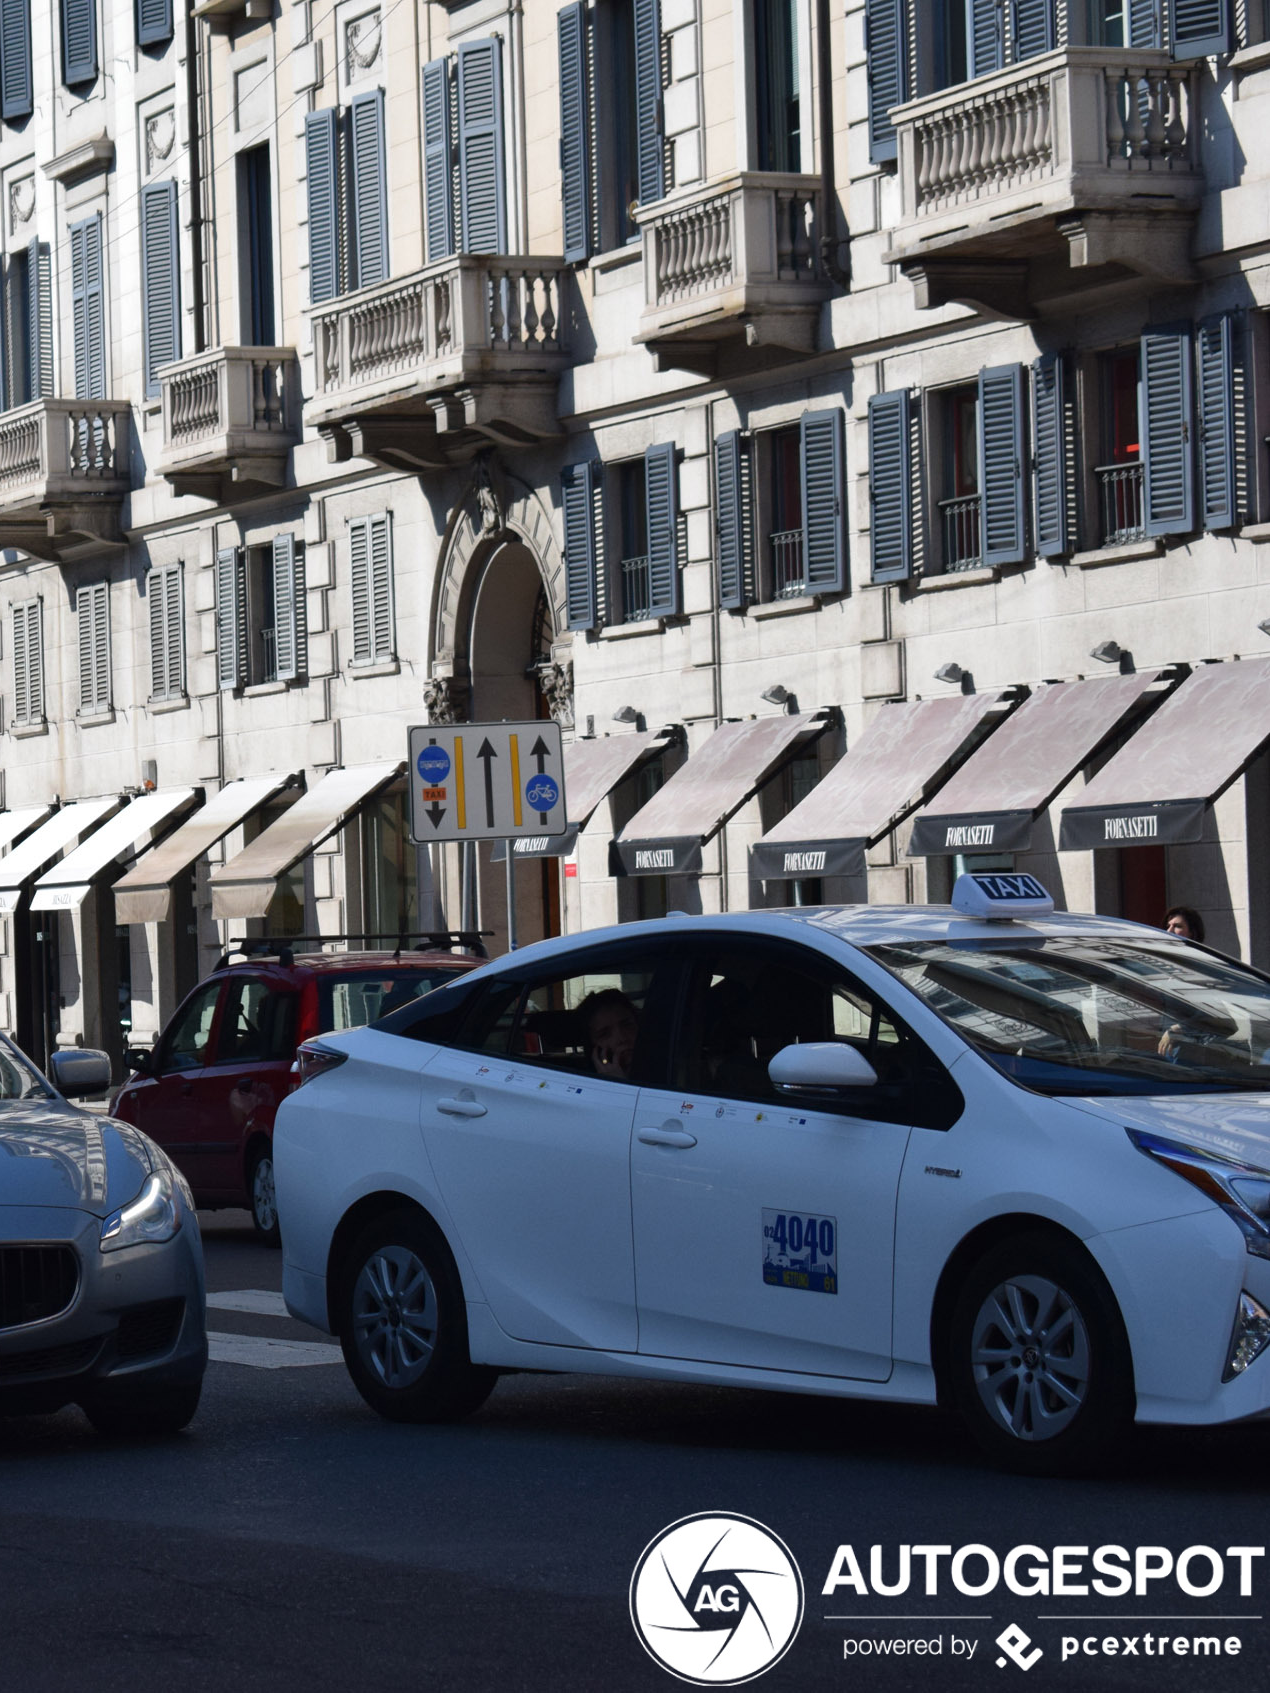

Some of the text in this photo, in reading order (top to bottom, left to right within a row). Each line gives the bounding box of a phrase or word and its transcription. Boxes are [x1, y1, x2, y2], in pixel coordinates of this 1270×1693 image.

[425, 790, 446, 800] TAXI
[945, 825, 995, 847] FORNASETTI
[1104, 815, 1158, 840] FORNASETTI
[635, 849, 675, 869] FORNASETTI
[783, 851, 827, 872] FORNASETTI
[976, 877, 1043, 897] TAXI
[773, 1214, 834, 1264] 4040
